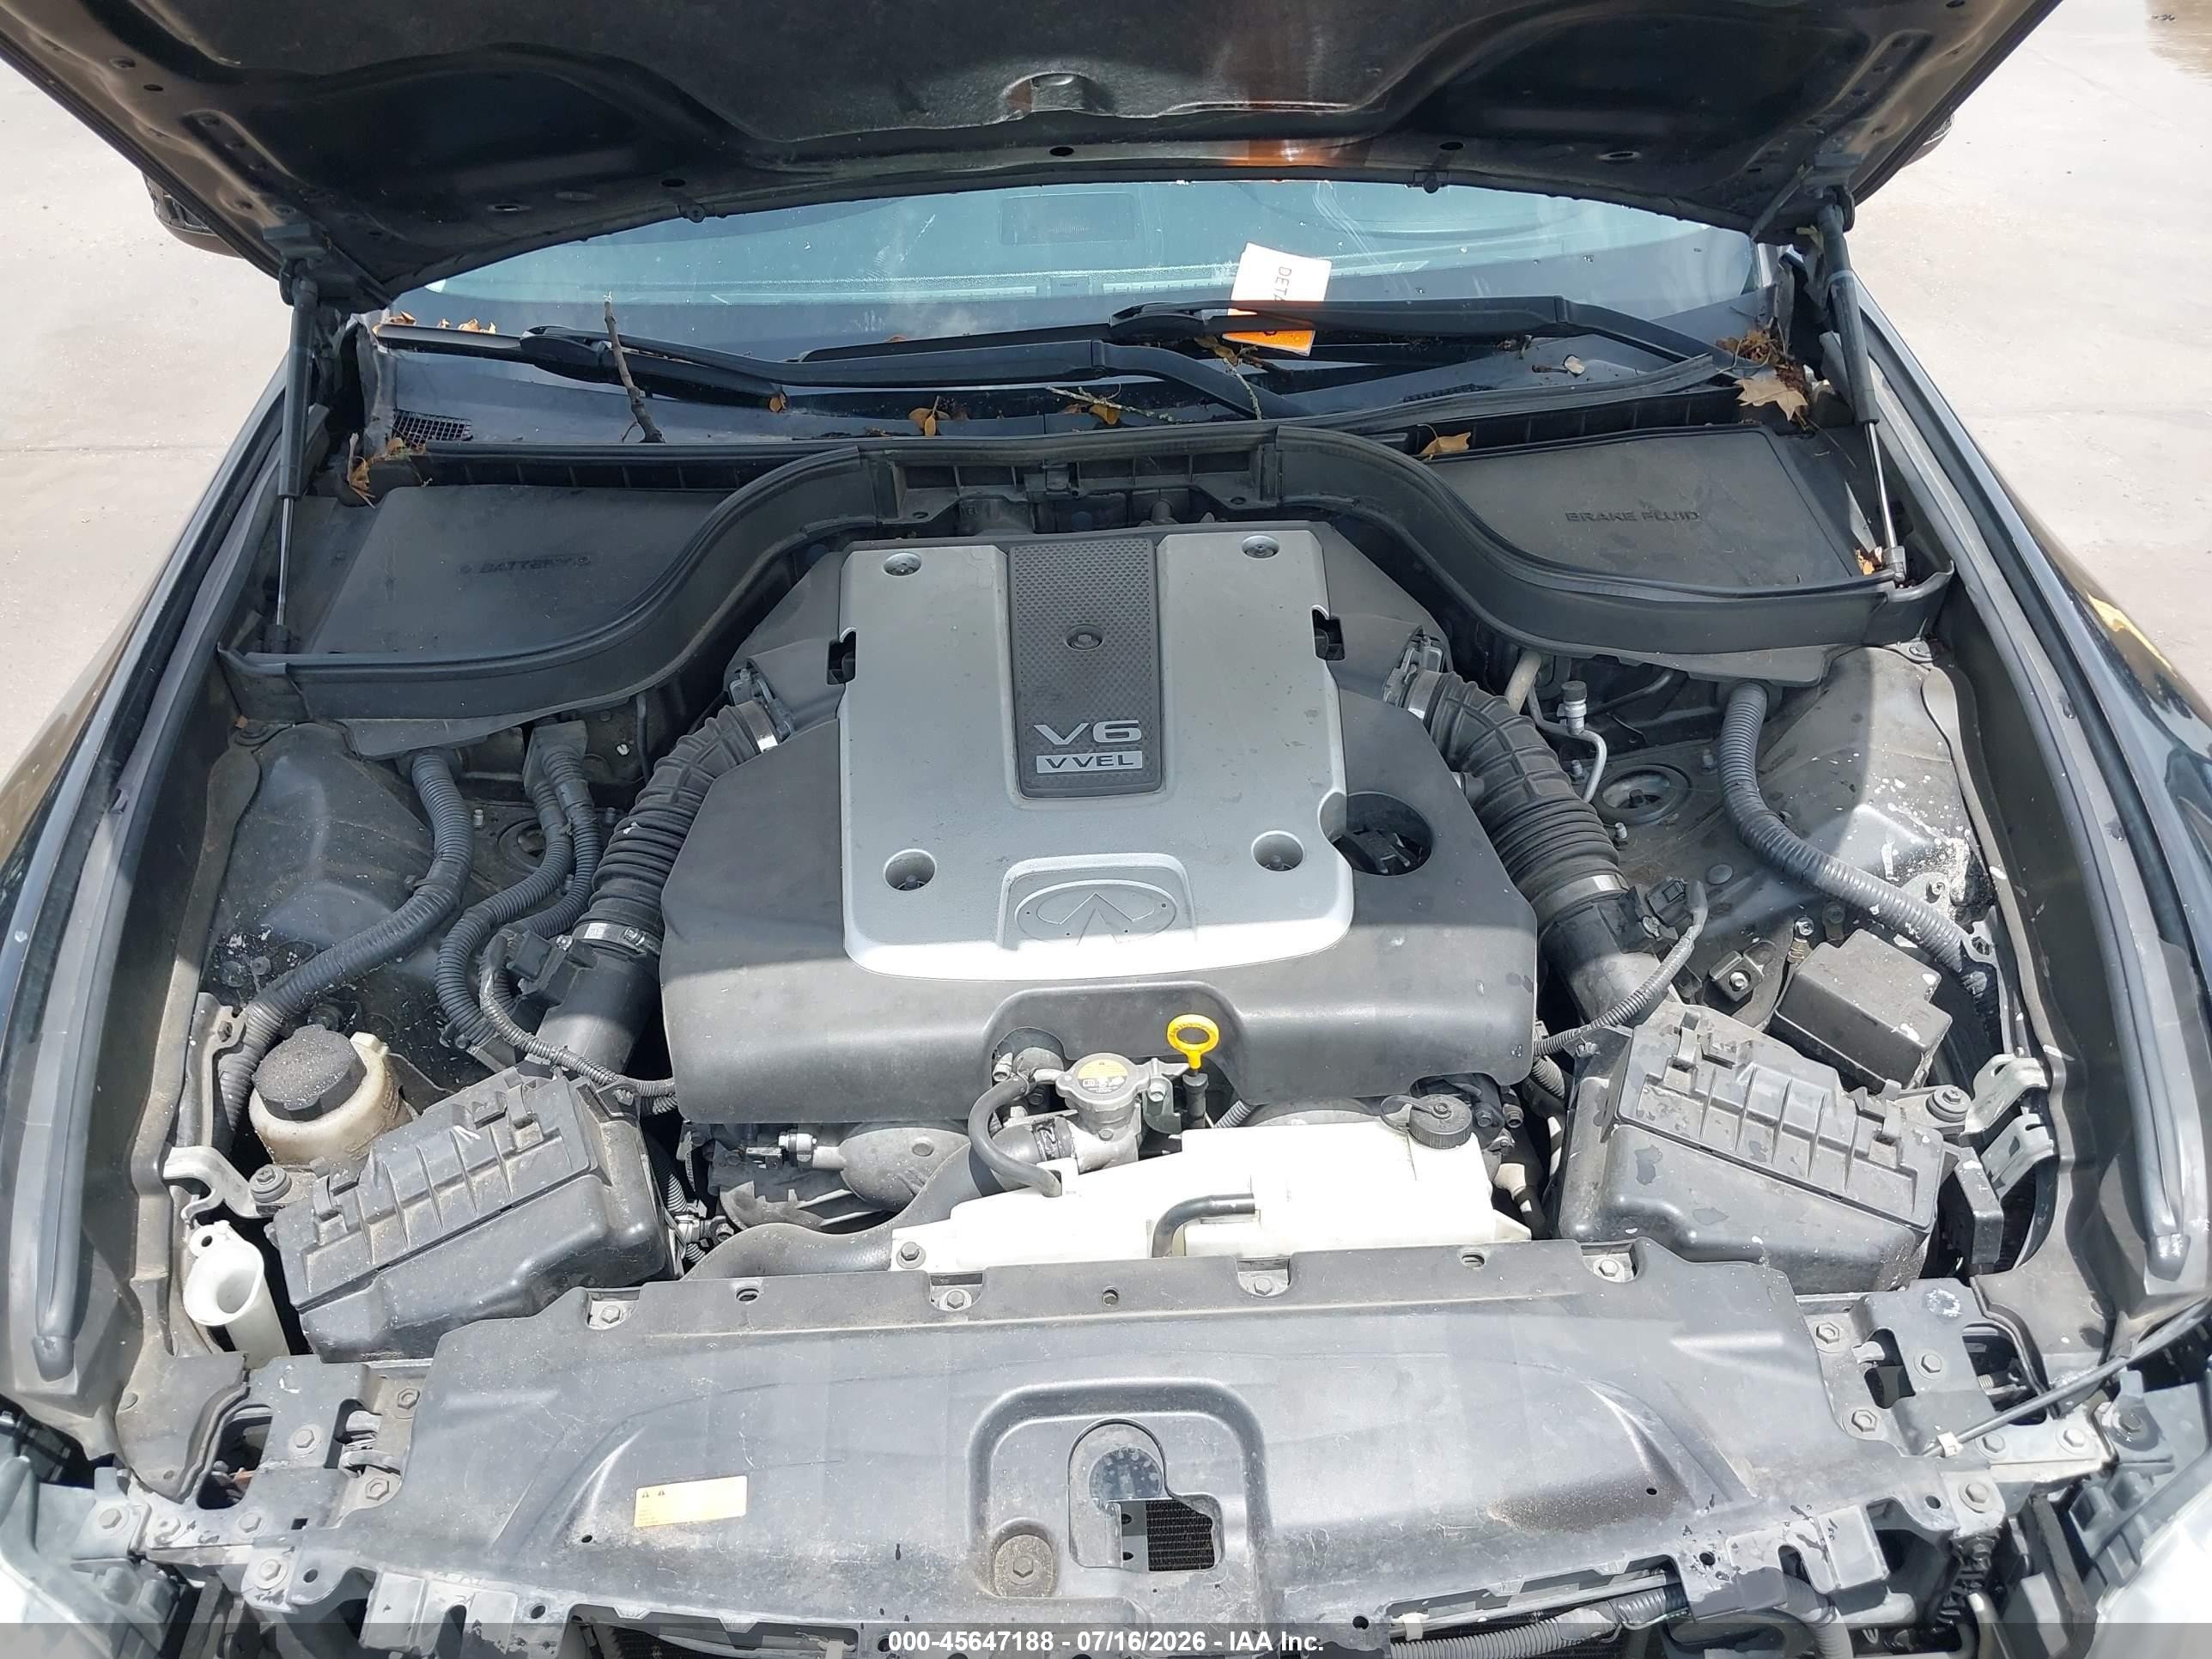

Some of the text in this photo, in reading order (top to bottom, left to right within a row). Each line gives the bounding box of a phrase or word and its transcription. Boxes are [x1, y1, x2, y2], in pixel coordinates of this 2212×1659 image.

[1565, 510, 1701, 522] BRAKE FLUID
[1033, 720, 1142, 745] V6
[1044, 753, 1135, 769] VVEL
